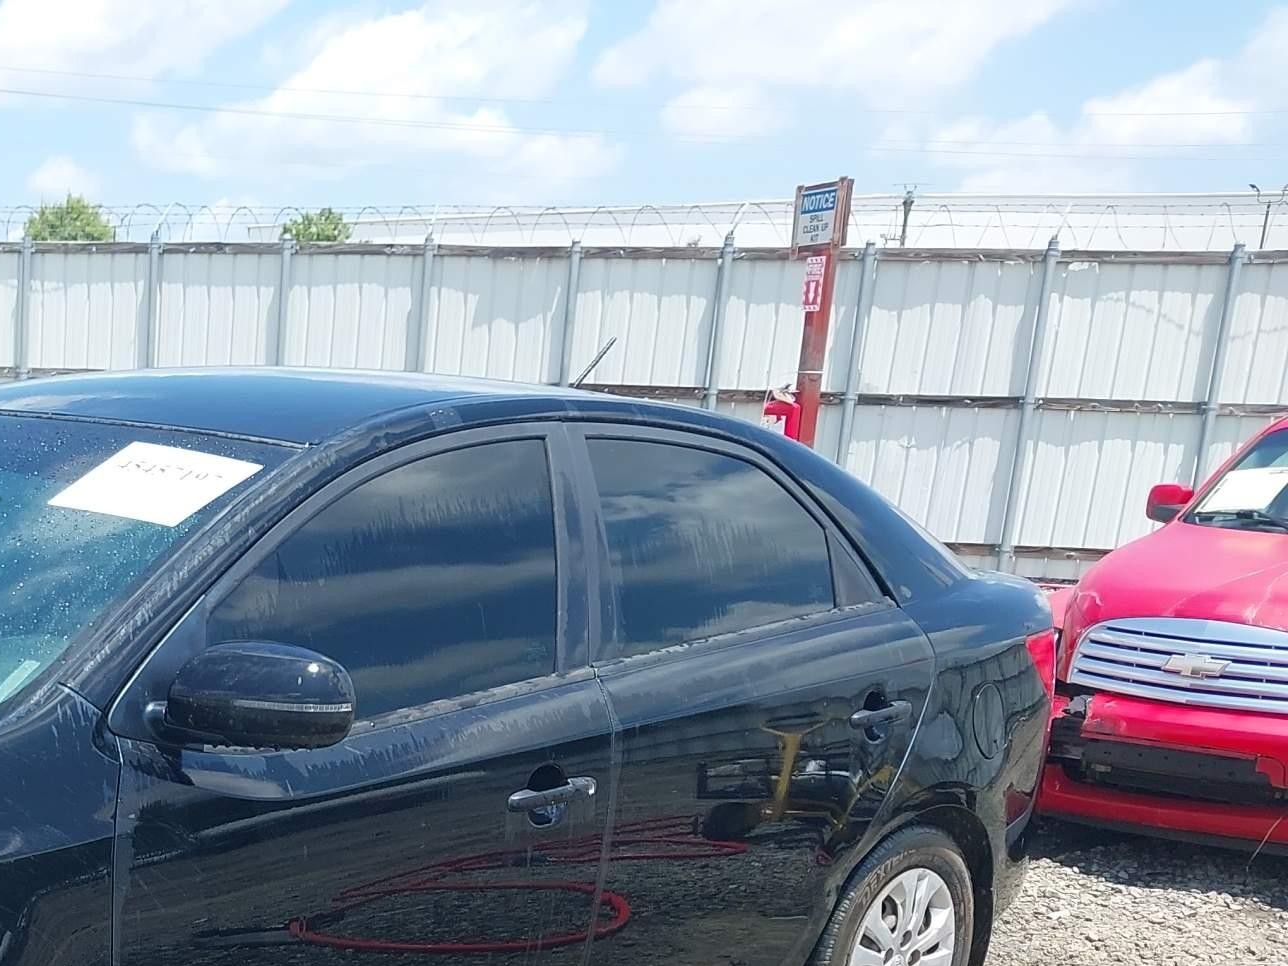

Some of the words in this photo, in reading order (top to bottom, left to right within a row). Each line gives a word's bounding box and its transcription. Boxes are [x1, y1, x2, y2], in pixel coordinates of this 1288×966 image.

[802, 192, 836, 212] NOTICE
[803, 224, 819, 234] CLEAN
[821, 222, 829, 232] UP
